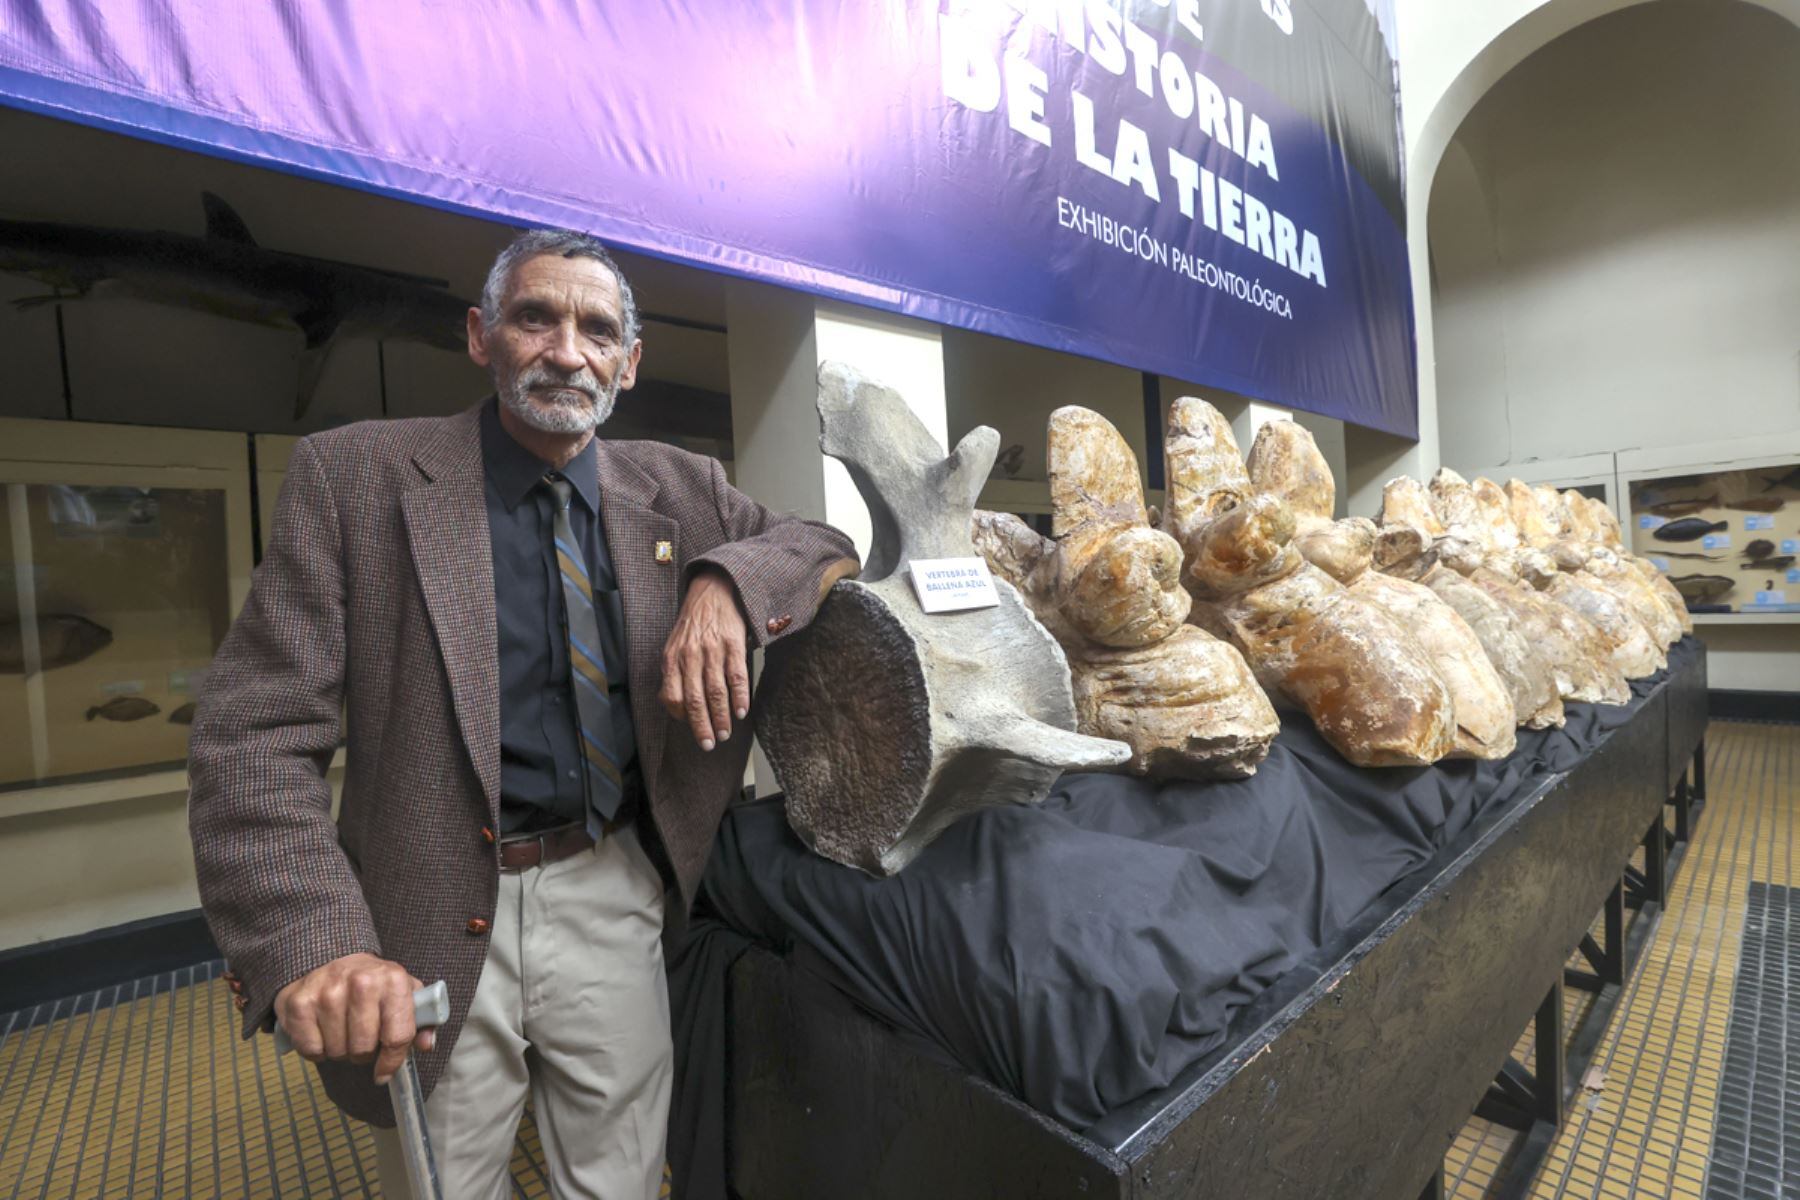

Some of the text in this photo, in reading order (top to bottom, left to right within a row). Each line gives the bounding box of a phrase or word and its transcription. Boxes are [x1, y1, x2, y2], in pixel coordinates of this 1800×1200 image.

[937, 13, 1327, 288] DE LA TIERRA
[1057, 196, 1293, 320] EXHIBICIÓN PALEONTOLÓGICA
[926, 579, 987, 592] BALLENA AZUL
[967, 568, 980, 577] DE
